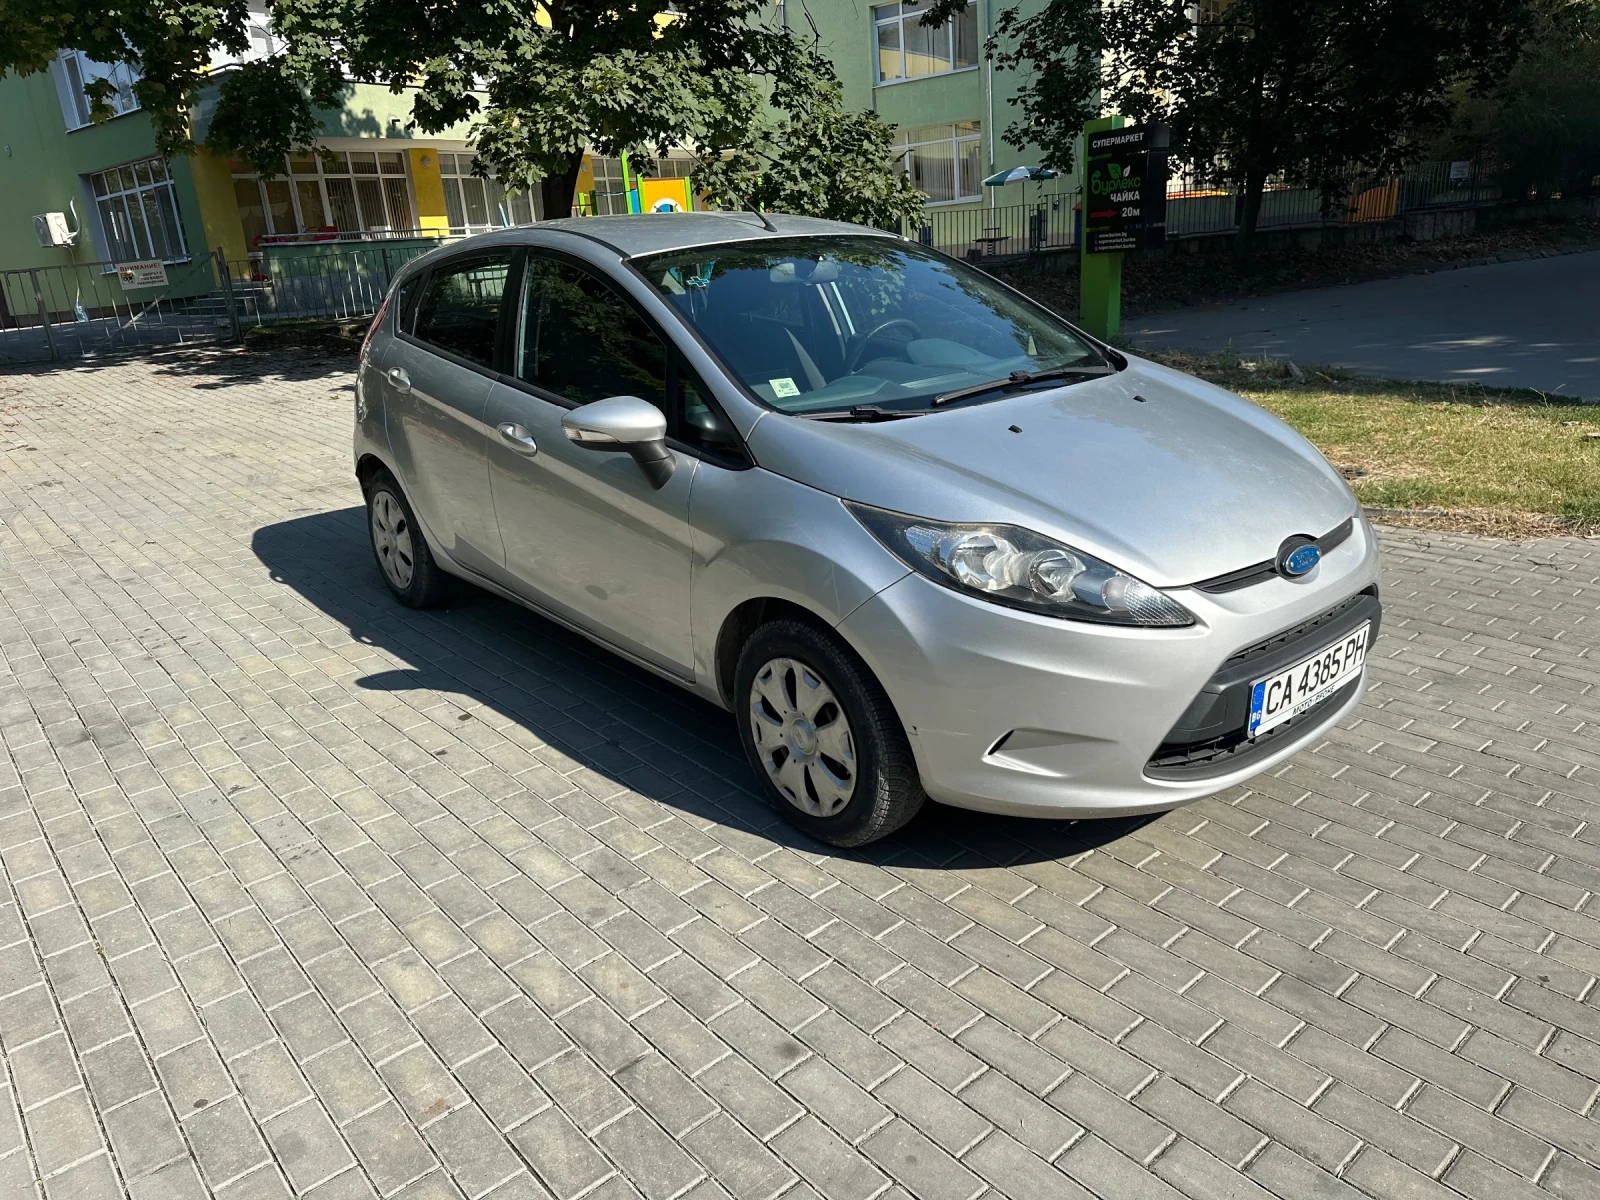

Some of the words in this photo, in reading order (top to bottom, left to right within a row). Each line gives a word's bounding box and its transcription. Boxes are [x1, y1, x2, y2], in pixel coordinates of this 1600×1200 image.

[1092, 132, 1144, 148] СУПЕРМАРКЕТ
[1110, 190, 1140, 202] ЧАЙКА
[120, 263, 160, 271] ВНИМАНИЕ!
[1266, 674, 1292, 715] CA
[1297, 645, 1343, 697] 4385
[1343, 630, 1367, 672] PH
[1251, 710, 1261, 722] BG
